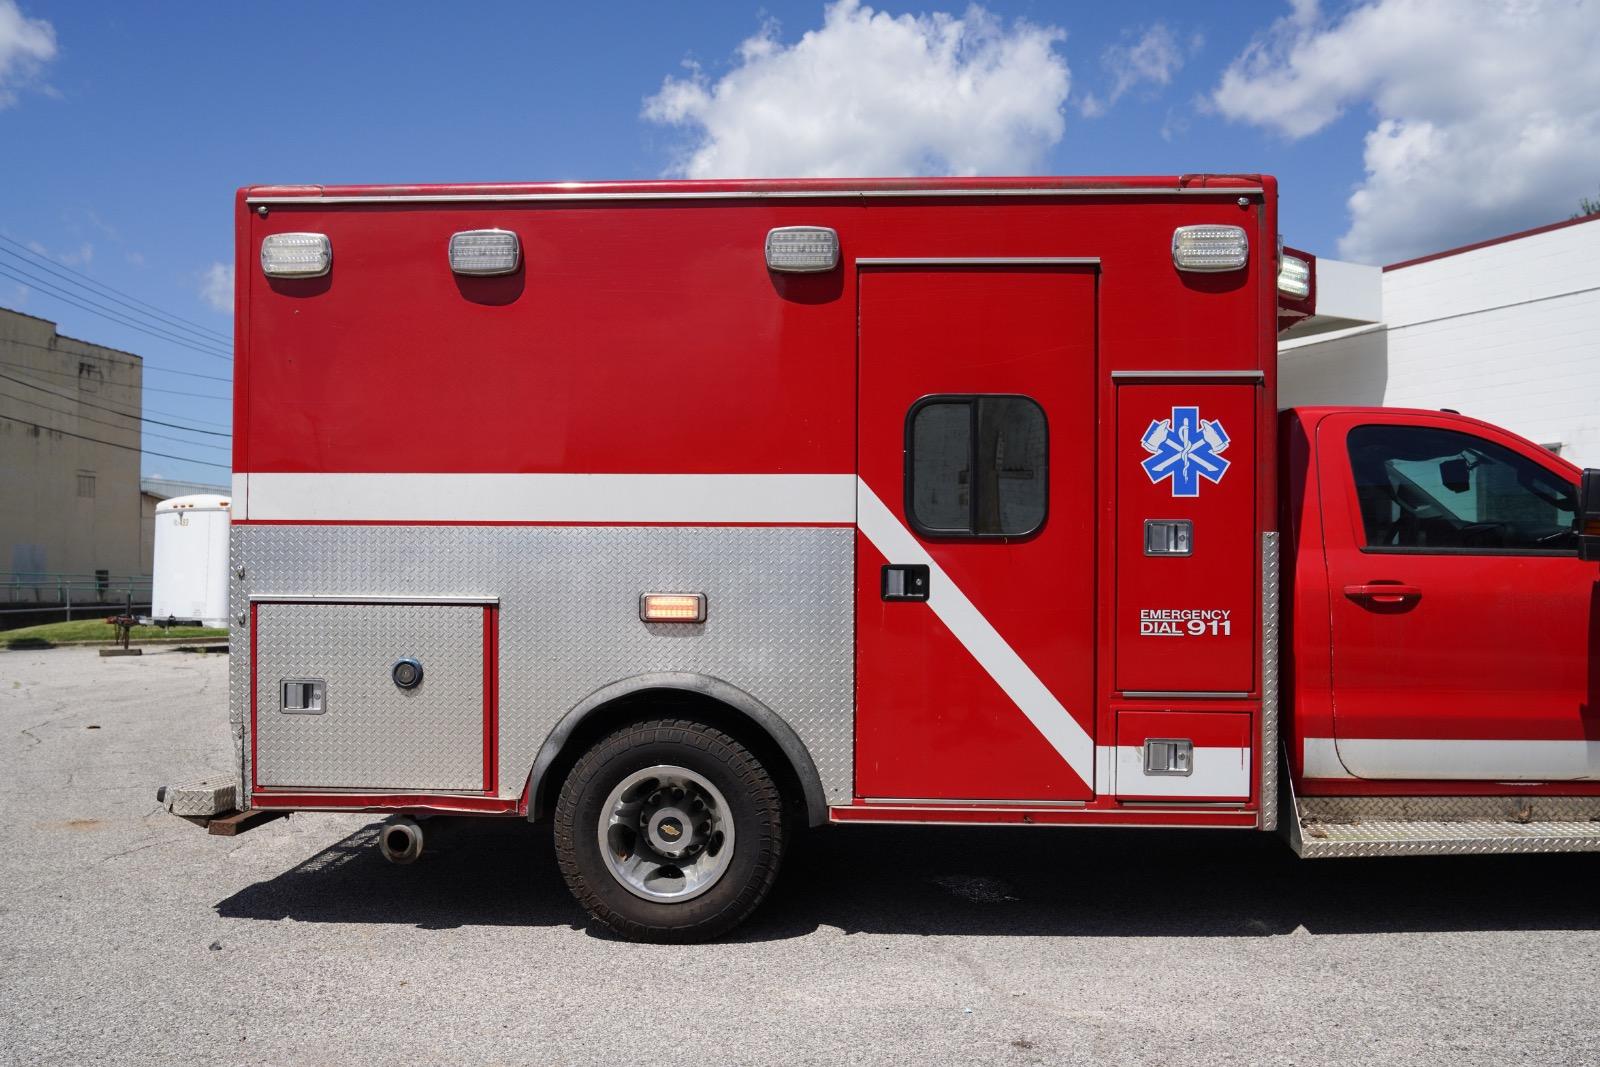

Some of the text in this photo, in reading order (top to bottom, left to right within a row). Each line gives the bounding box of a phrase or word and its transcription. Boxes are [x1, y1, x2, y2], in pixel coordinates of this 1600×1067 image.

[1140, 609, 1231, 620] EMERGENCY
[1140, 620, 1231, 636] DIAL 911
